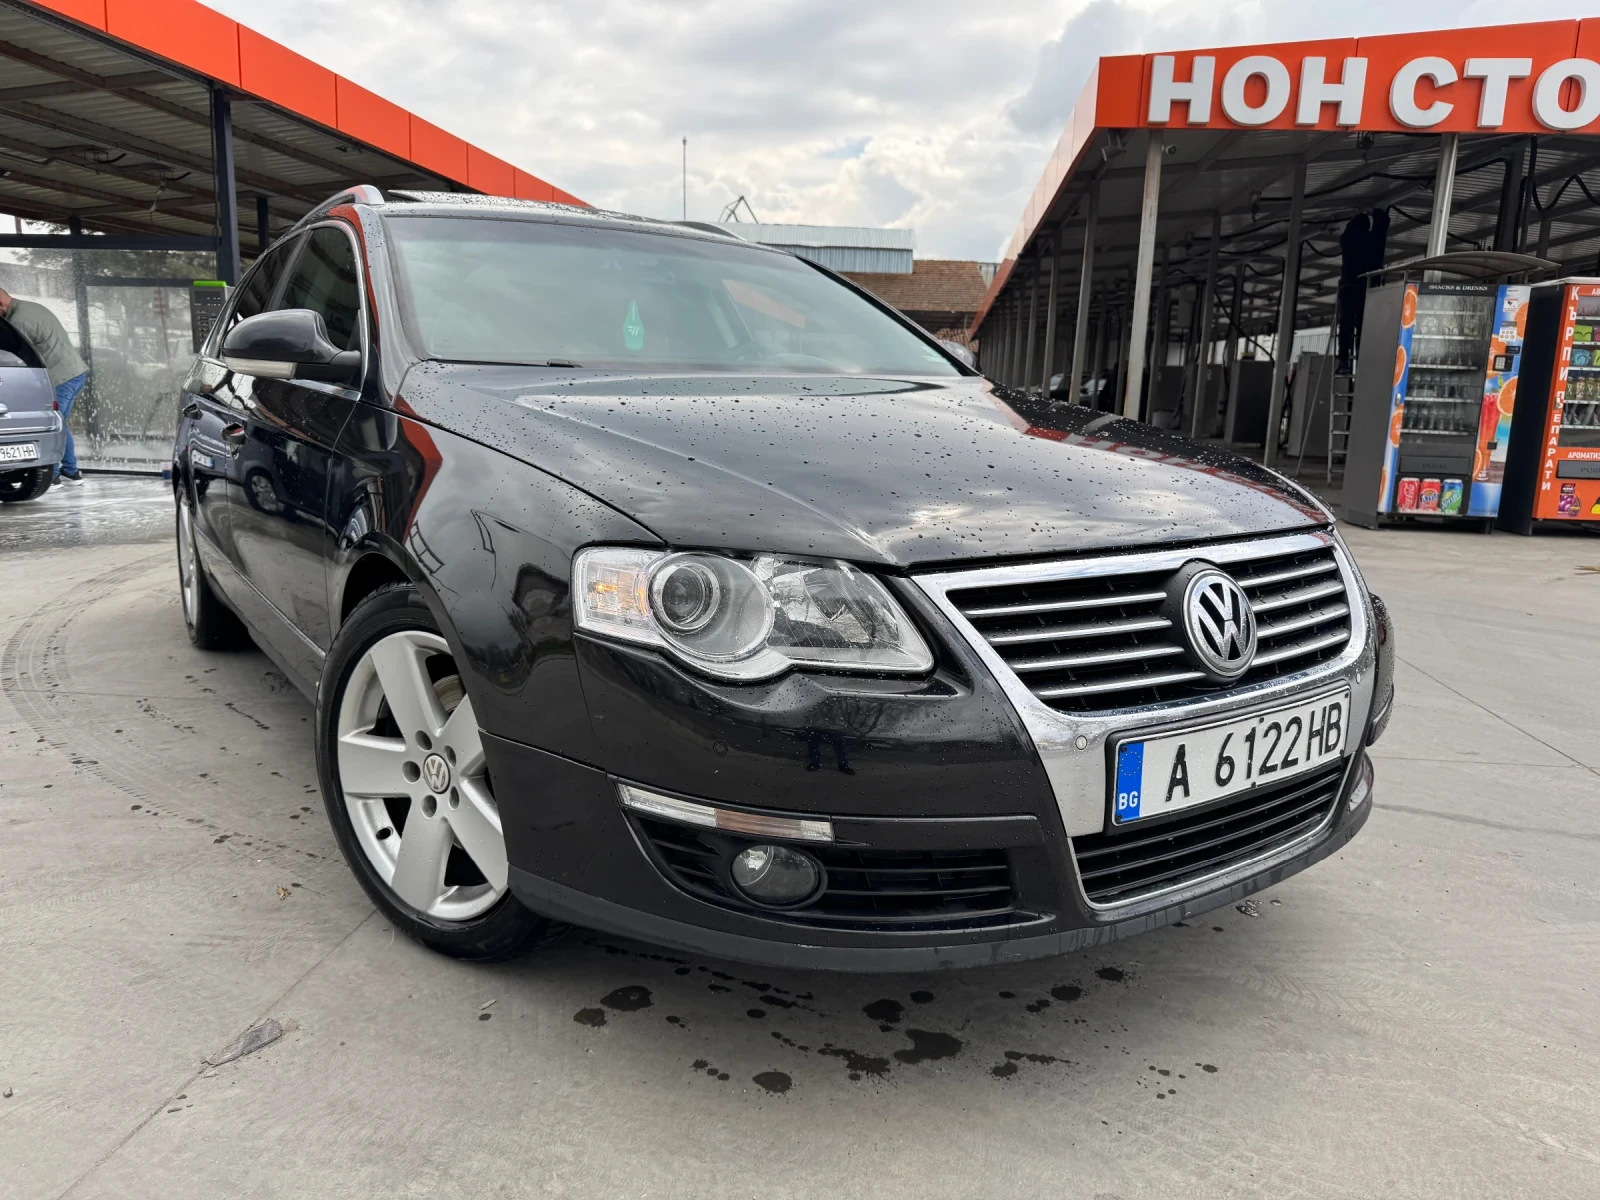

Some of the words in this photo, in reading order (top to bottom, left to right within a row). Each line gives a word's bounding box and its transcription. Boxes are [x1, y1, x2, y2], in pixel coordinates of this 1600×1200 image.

[1147, 55, 1368, 127] НОН
[1389, 56, 1600, 131] СТО
[1118, 791, 1138, 810] BG
[1165, 743, 1190, 802] A
